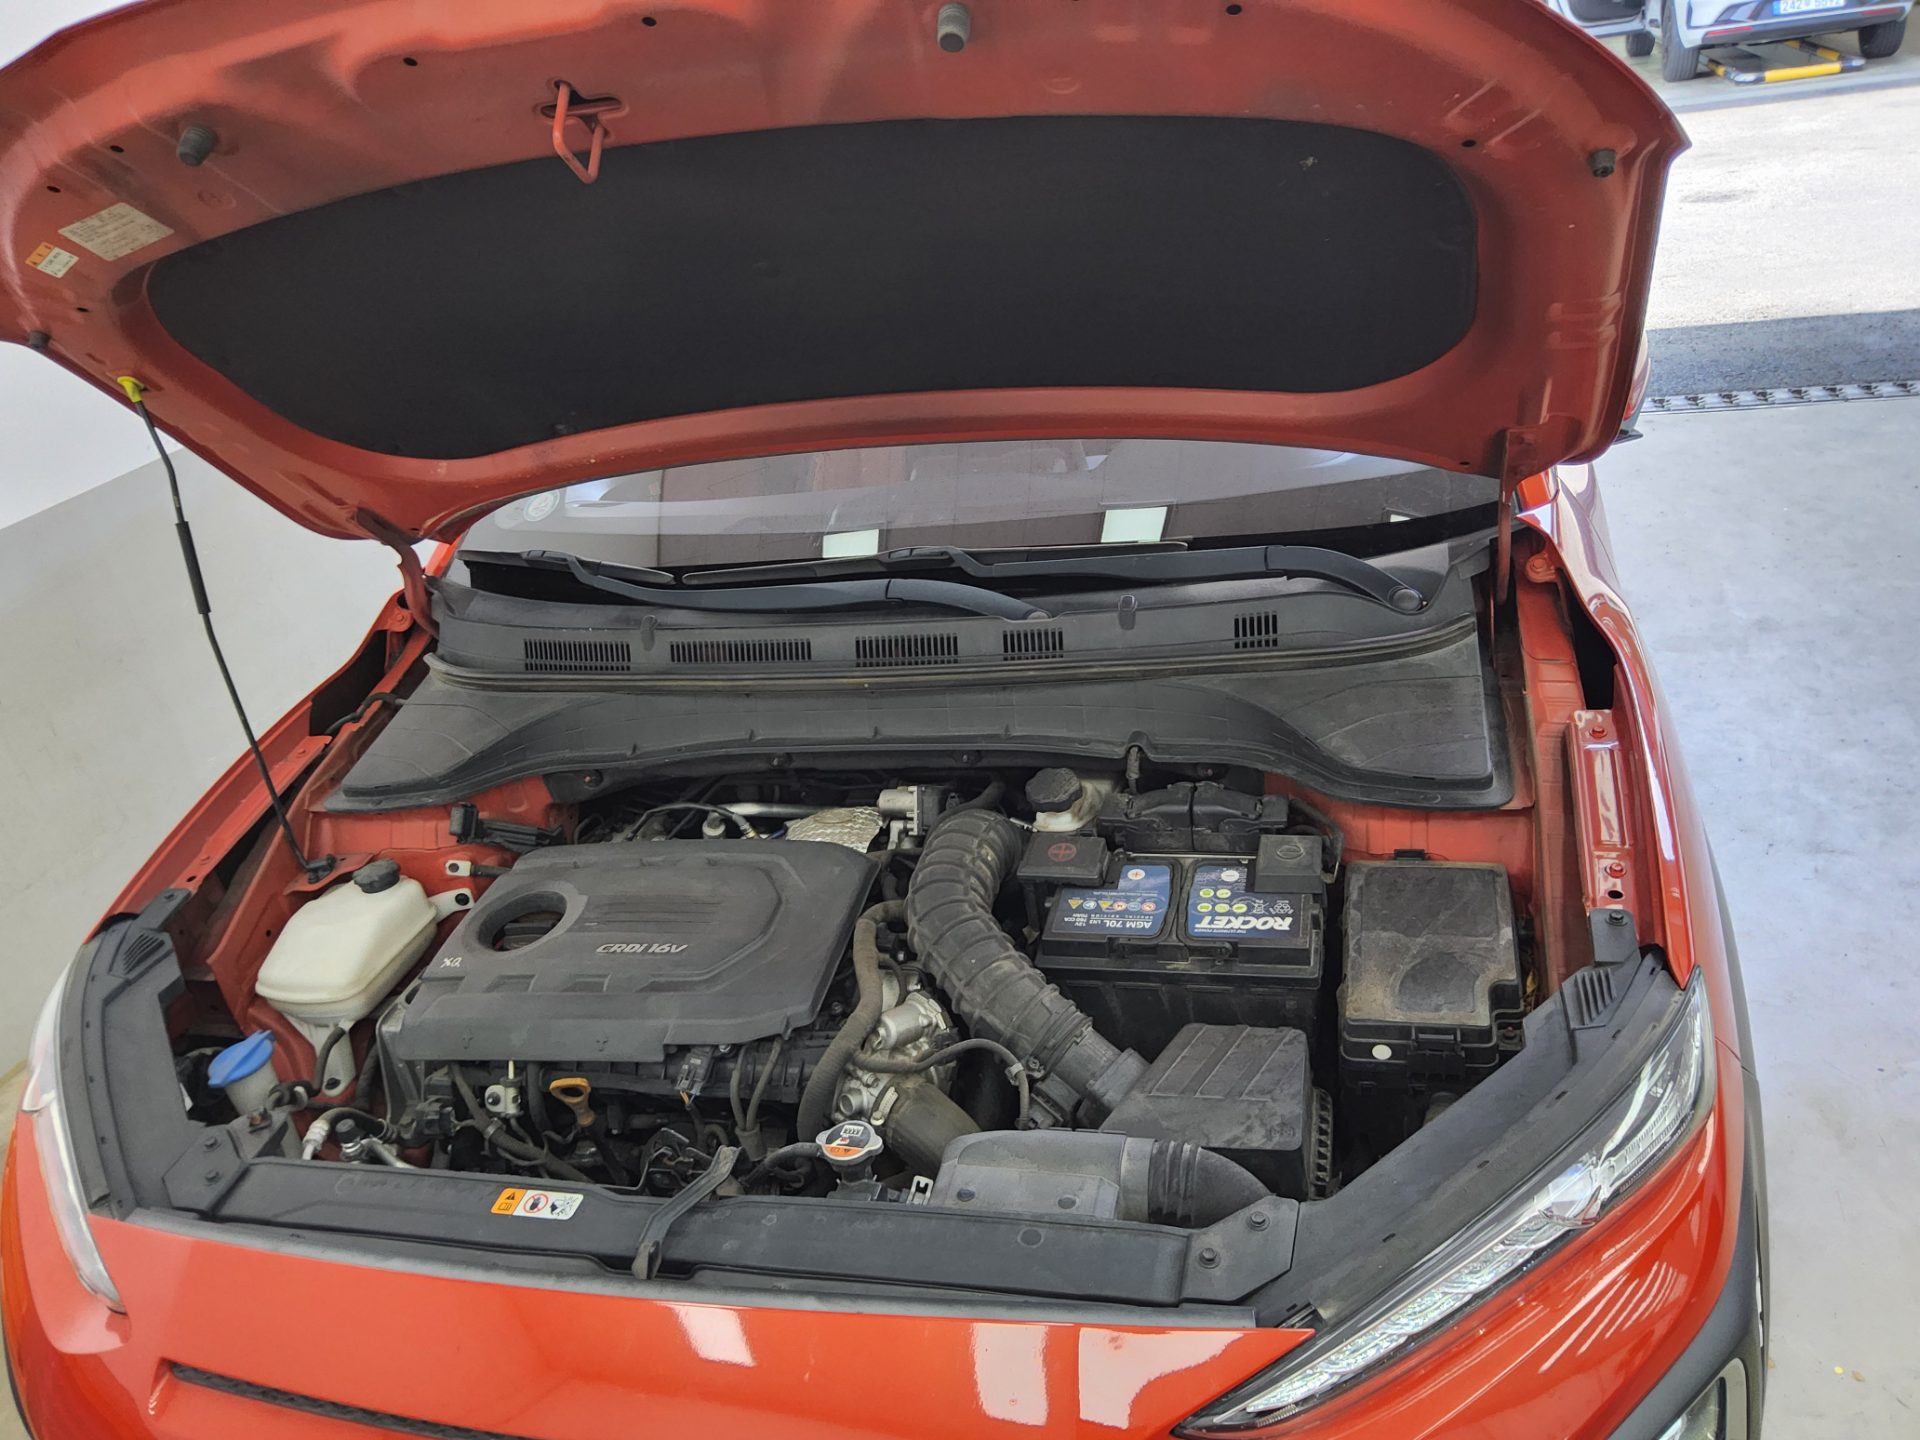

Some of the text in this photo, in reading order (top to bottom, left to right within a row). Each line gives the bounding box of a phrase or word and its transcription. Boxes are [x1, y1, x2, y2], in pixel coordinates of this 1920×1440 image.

[1104, 920, 1123, 928] 70L
[1195, 915, 1293, 931] ROCKET
[648, 943, 689, 953] 16V
